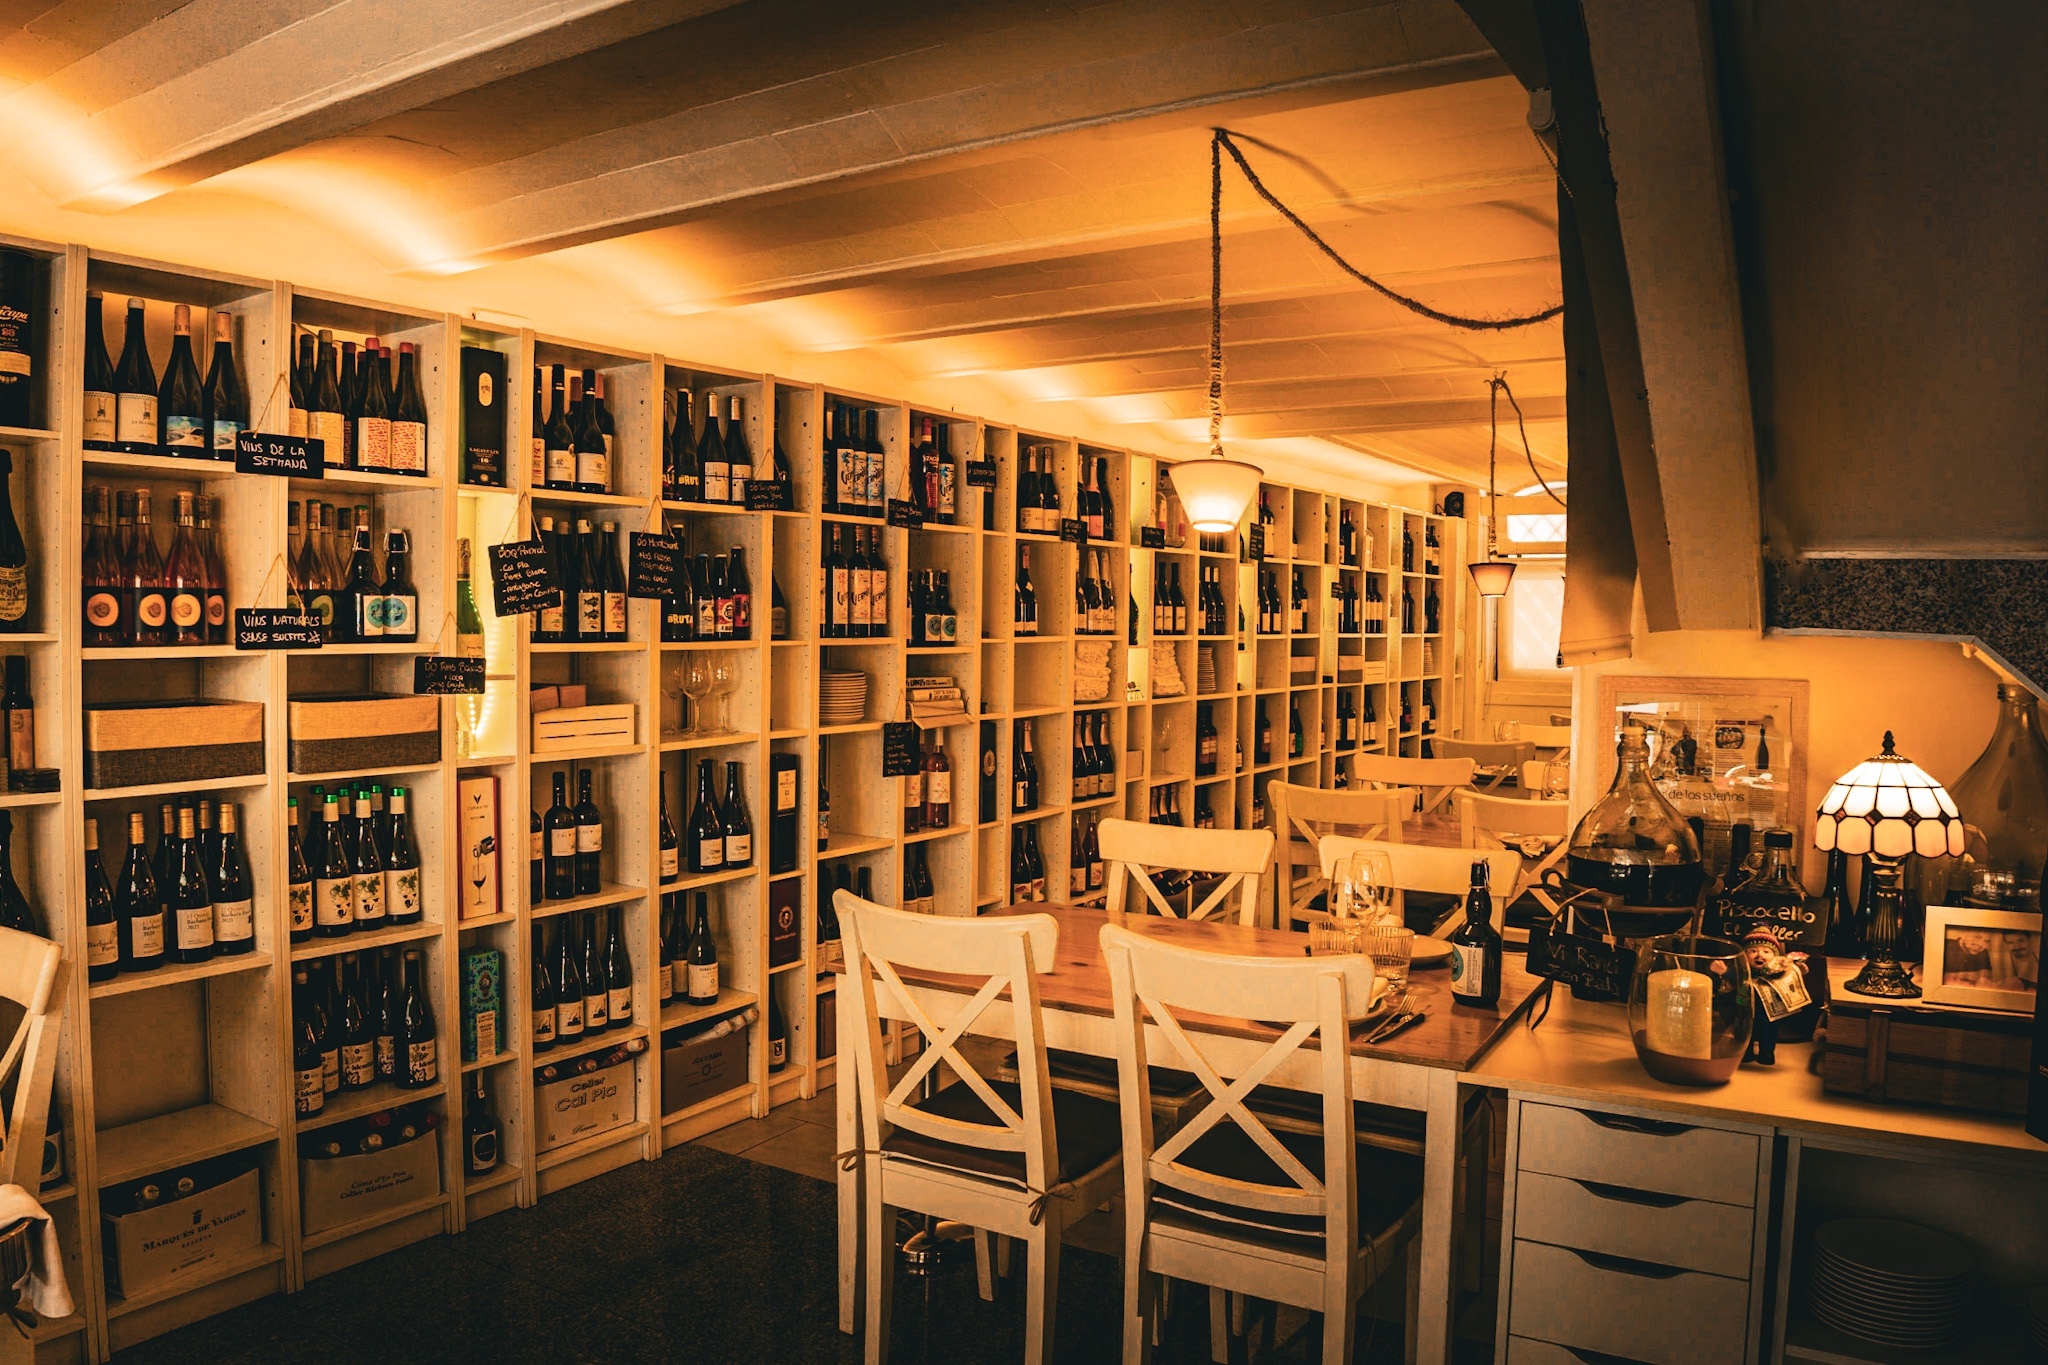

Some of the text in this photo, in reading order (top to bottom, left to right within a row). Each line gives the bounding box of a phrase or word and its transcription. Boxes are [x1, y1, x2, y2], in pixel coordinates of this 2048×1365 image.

[240, 440, 306, 456] VINS DE LA
[253, 455, 308, 470] SETMANA
[678, 475, 699, 486] BRUT
[498, 549, 518, 559] DOQ
[517, 561, 530, 569] Pla
[242, 615, 320, 627] VINS NATURALS
[240, 631, 306, 643] SENSE SULFITS
[1669, 789, 1745, 802] de los sueños
[1717, 899, 1816, 923] Piscocello
[1548, 940, 1619, 974] Vi Ranci
[570, 1077, 606, 1093] Celler
[555, 1085, 617, 1112] Cal Pla
[197, 1223, 210, 1233] DE
